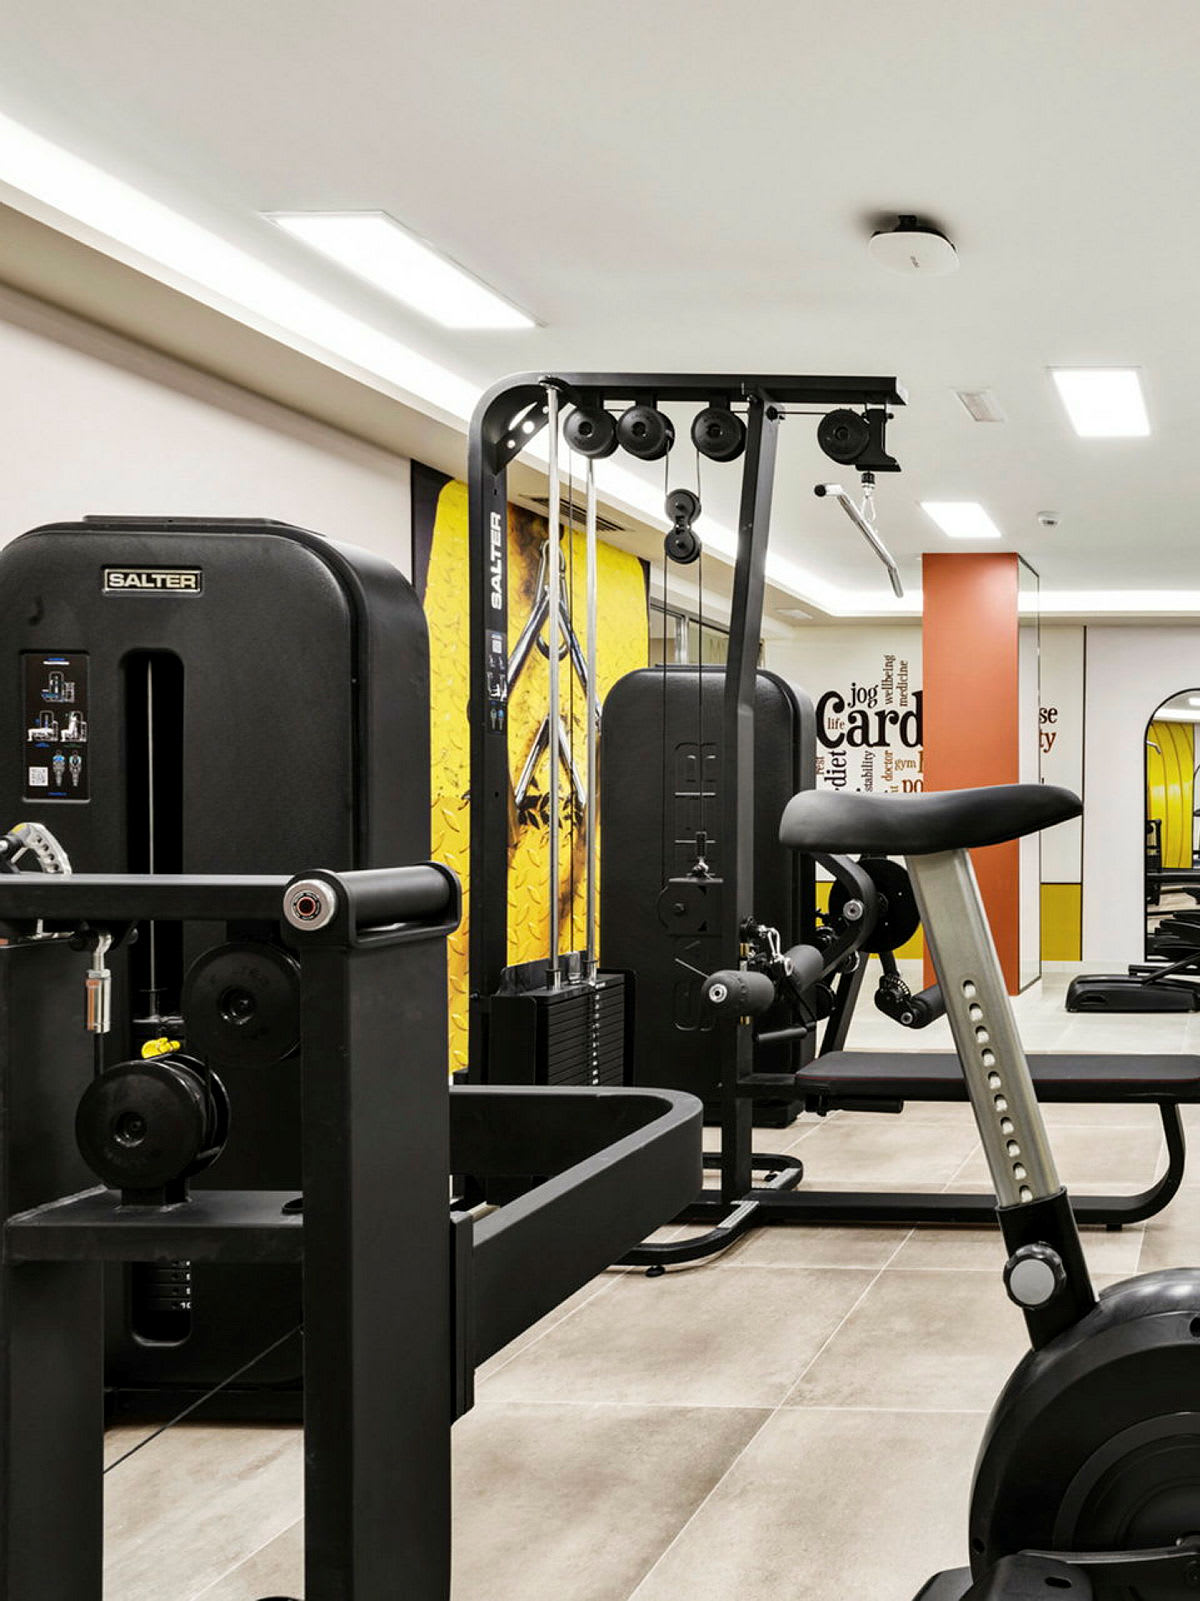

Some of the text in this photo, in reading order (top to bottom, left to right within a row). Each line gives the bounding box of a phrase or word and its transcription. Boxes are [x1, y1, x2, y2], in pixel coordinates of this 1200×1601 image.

[490, 512, 502, 610] SALTER
[109, 573, 196, 589] SALTER
[848, 682, 879, 708] jog
[881, 654, 896, 705] wellbeing
[896, 660, 908, 707] medicine
[827, 717, 846, 731] life
[824, 750, 847, 788] diet
[860, 750, 876, 792] stability
[880, 750, 894, 782] doctor
[894, 758, 917, 771] gym
